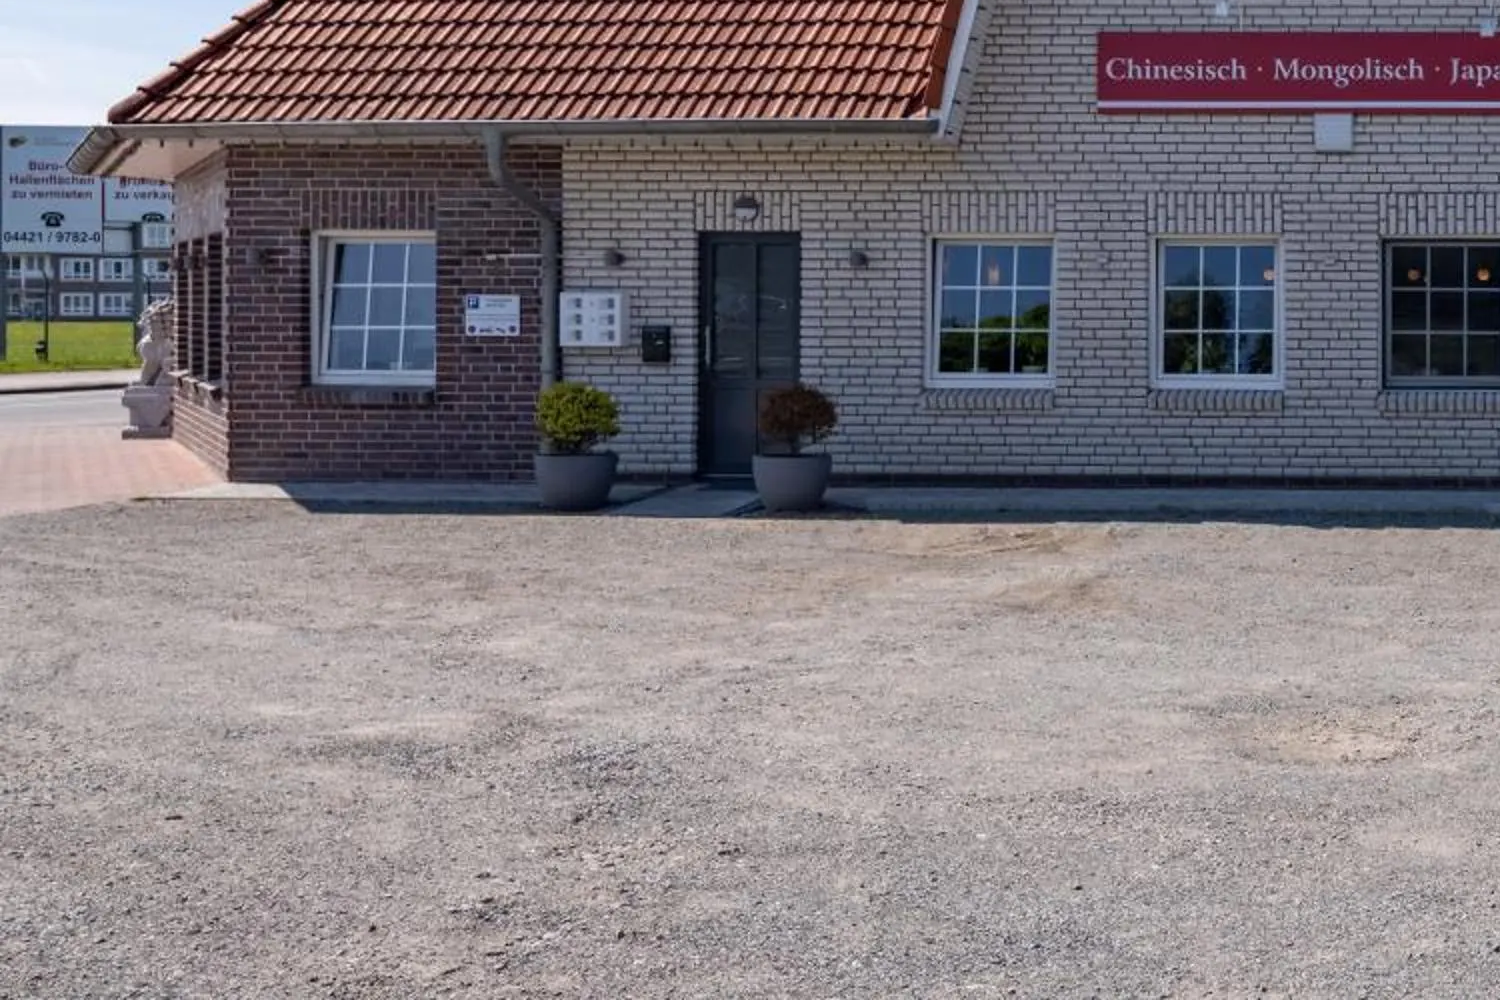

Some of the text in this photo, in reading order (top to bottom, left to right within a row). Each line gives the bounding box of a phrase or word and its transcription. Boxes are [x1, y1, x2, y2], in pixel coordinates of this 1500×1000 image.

[1104, 57, 1247, 81] Chinesisch
[1273, 57, 1425, 88] Mongolisch
[4, 231, 43, 242] 04421
